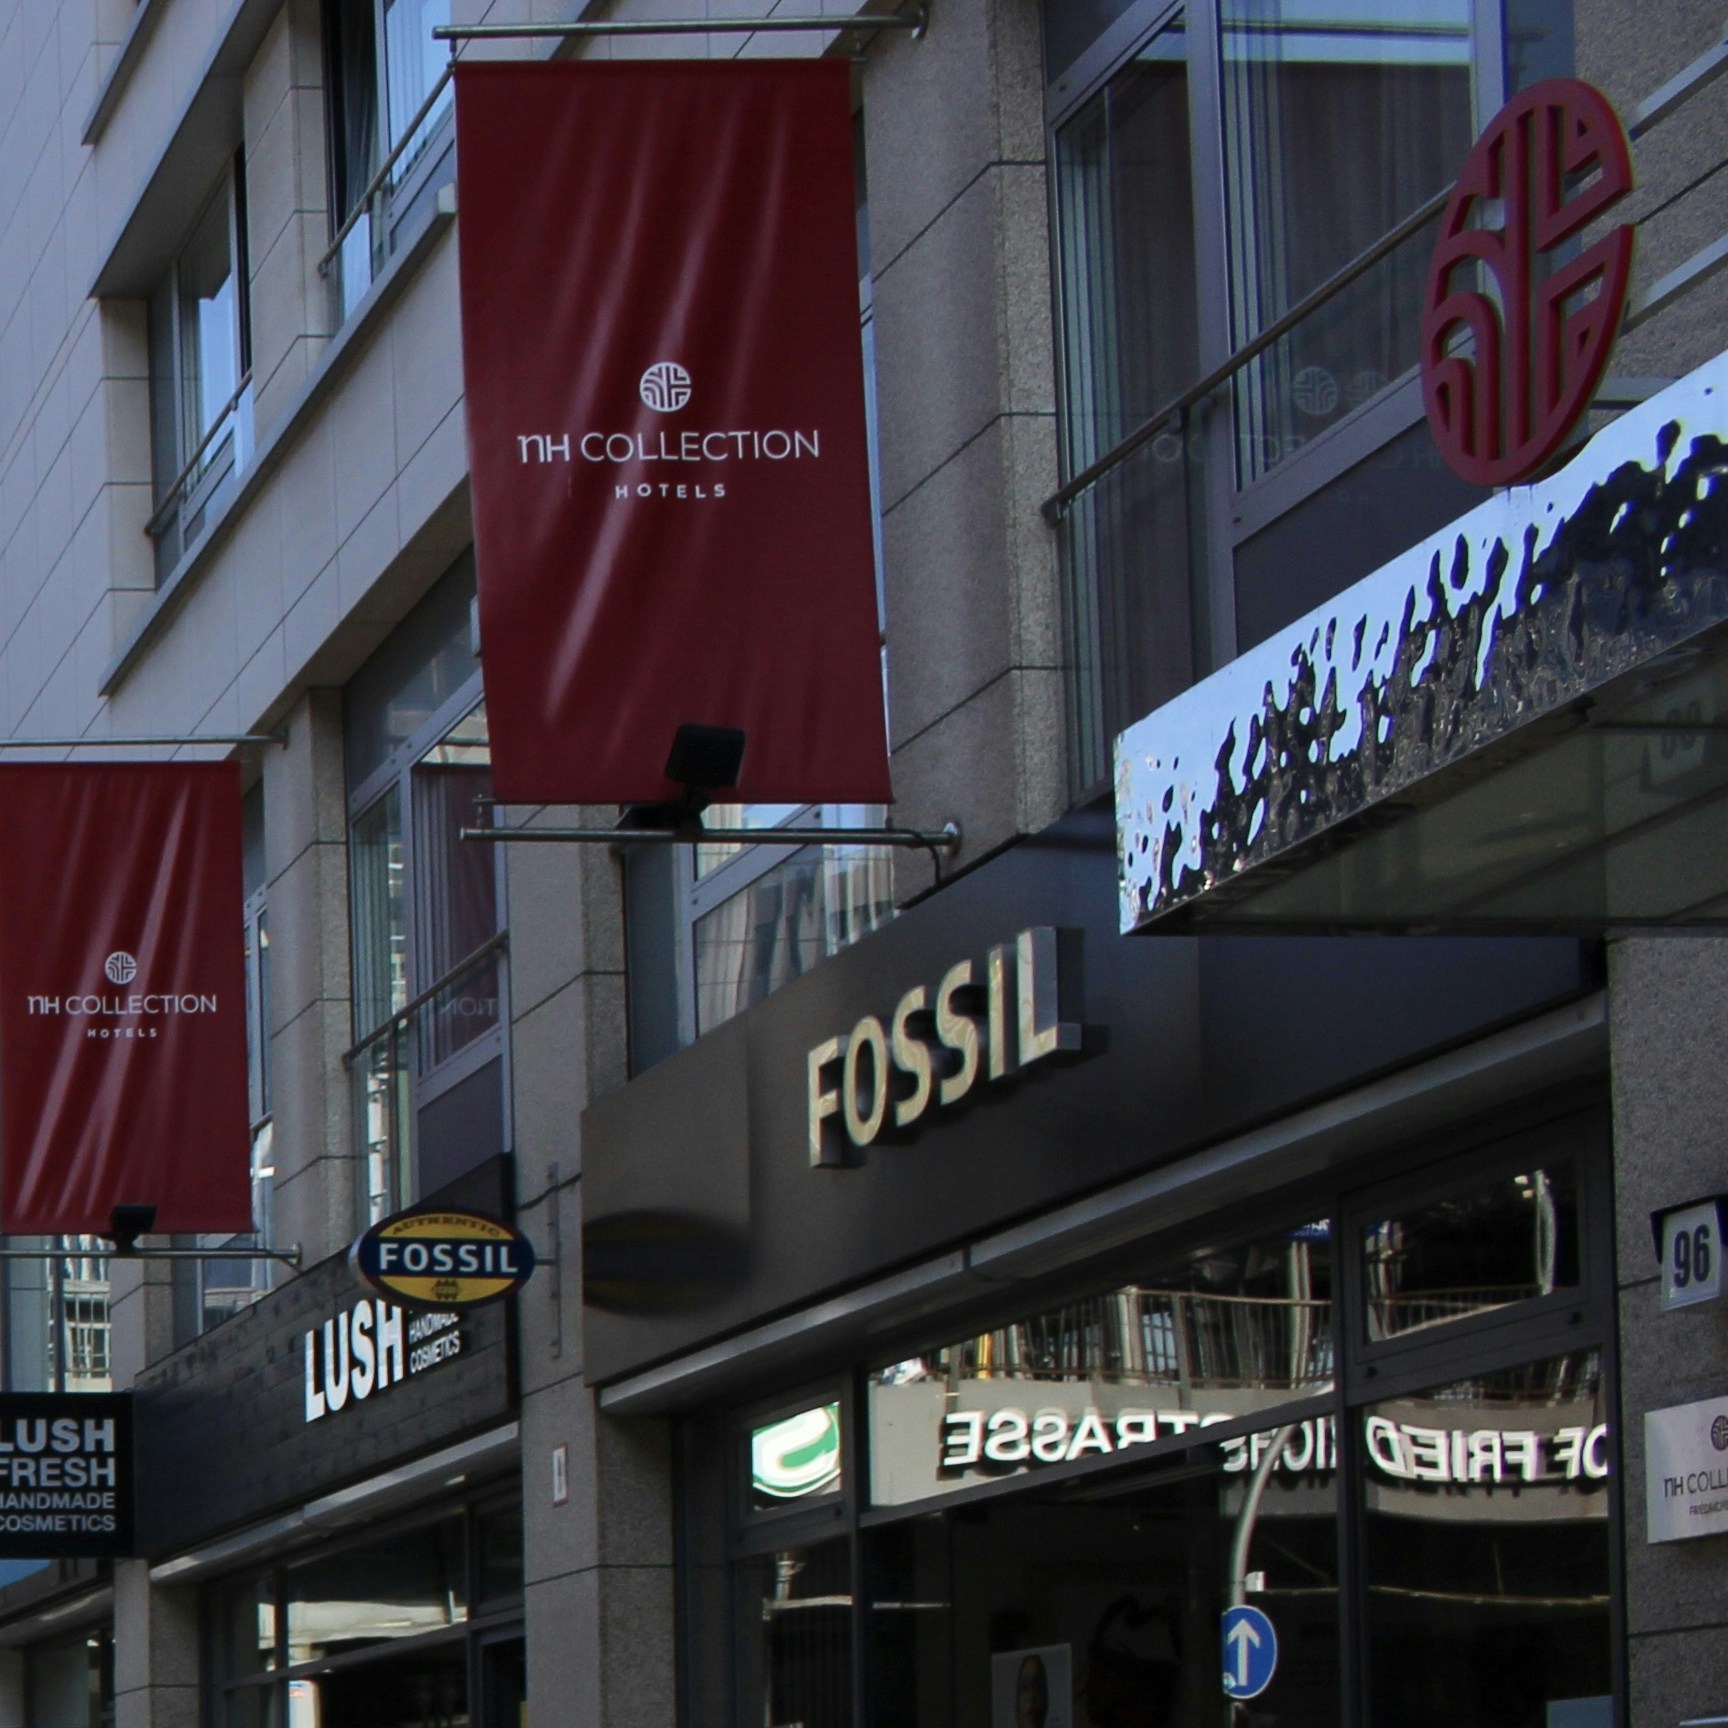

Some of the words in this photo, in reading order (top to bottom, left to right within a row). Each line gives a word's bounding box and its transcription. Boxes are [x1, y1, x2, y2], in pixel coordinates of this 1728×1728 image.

[580, 429, 820, 463] COLLECTION
[615, 483, 725, 499] HOTELS
[65, 994, 217, 1015] COLLECTION
[87, 1028, 157, 1038] HOTELS
[808, 926, 1062, 1168] FOSSIL
[392, 1215, 501, 1238] AUTHENTIC
[379, 1243, 519, 1273] FOSSIL
[1674, 1224, 1711, 1288] 96
[305, 1299, 404, 1423] LUSH
[410, 1330, 461, 1373] COSMETICS
